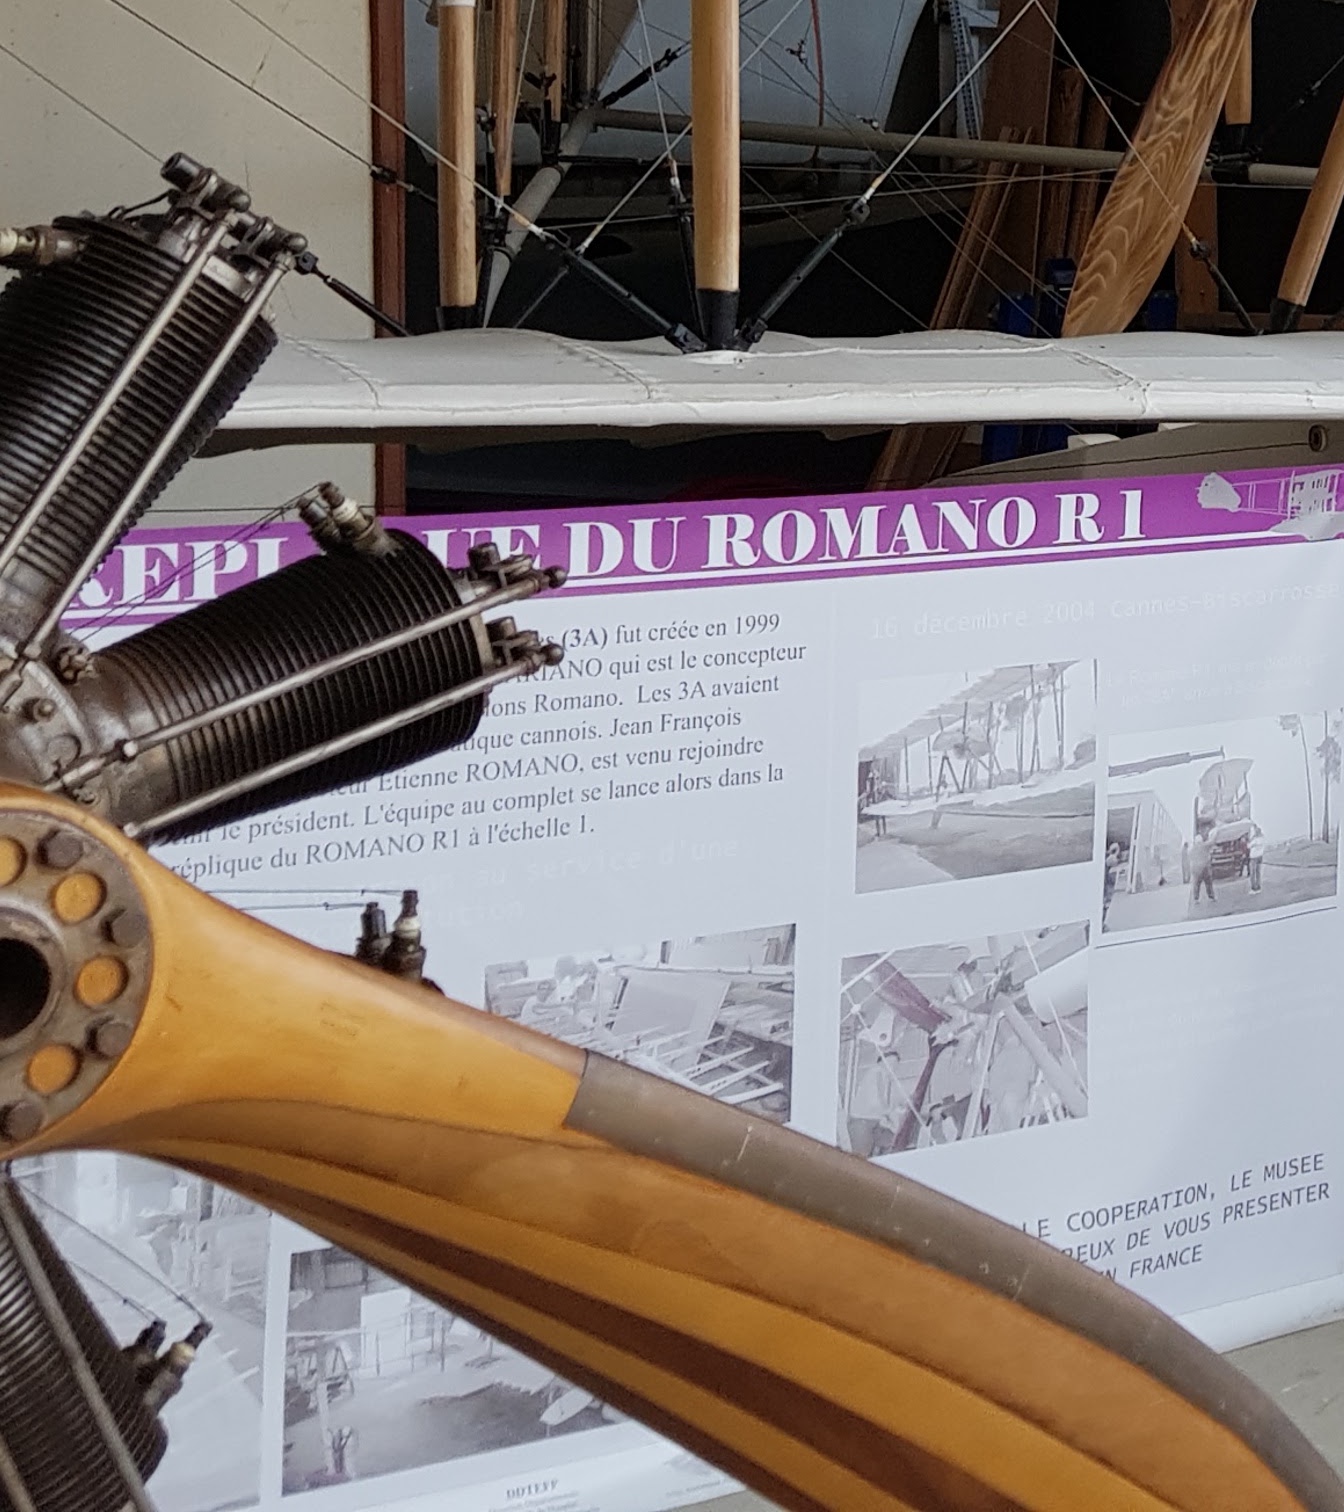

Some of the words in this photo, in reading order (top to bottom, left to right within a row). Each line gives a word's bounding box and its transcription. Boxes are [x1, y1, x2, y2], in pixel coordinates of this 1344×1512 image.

[562, 515, 687, 578] DU
[700, 496, 1037, 569] ROMANO
[562, 627, 608, 650] (3A)
[615, 624, 643, 644] fut
[648, 620, 699, 641] créée
[705, 621, 727, 637] en
[735, 613, 780, 635] 1999
[609, 654, 640, 680] qui
[646, 655, 673, 673] est
[680, 650, 697, 670] le
[703, 645, 807, 669] concepteur
[534, 693, 624, 714] Romano.
[638, 684, 672, 705] Les
[678, 681, 707, 701] 3A
[711, 675, 779, 697] avaient
[520, 720, 602, 746] cannois.
[609, 717, 653, 738] Jean
[660, 707, 742, 733] François
[465, 752, 585, 783] ROMANO,
[591, 752, 618, 770] est
[626, 748, 672, 766] venu
[678, 736, 764, 765] rejoindre
[248, 810, 355, 843] président.
[364, 798, 455, 827] L'équipe
[461, 799, 486, 816] au
[492, 786, 574, 813] complet
[580, 787, 602, 803] se
[608, 779, 660, 800] lance
[665, 773, 712, 793] alors
[718, 767, 762, 788] dans
[768, 763, 784, 783] la
[171, 854, 263, 883] réplique
[270, 847, 297, 869] du
[306, 832, 425, 865] ROMANO
[432, 828, 458, 851] R1
[468, 826, 480, 846] à
[487, 817, 571, 844] l'échelle
[579, 814, 595, 834] 1.
[1066, 1183, 1216, 1233] COOPERATION,
[1230, 1170, 1253, 1192] LE
[1263, 1153, 1325, 1183] MUSEE
[1126, 1228, 1151, 1251] DE
[1164, 1211, 1211, 1240] VOUS
[1222, 1182, 1331, 1225] PRESENTER
[1130, 1244, 1204, 1279] FRANCE
